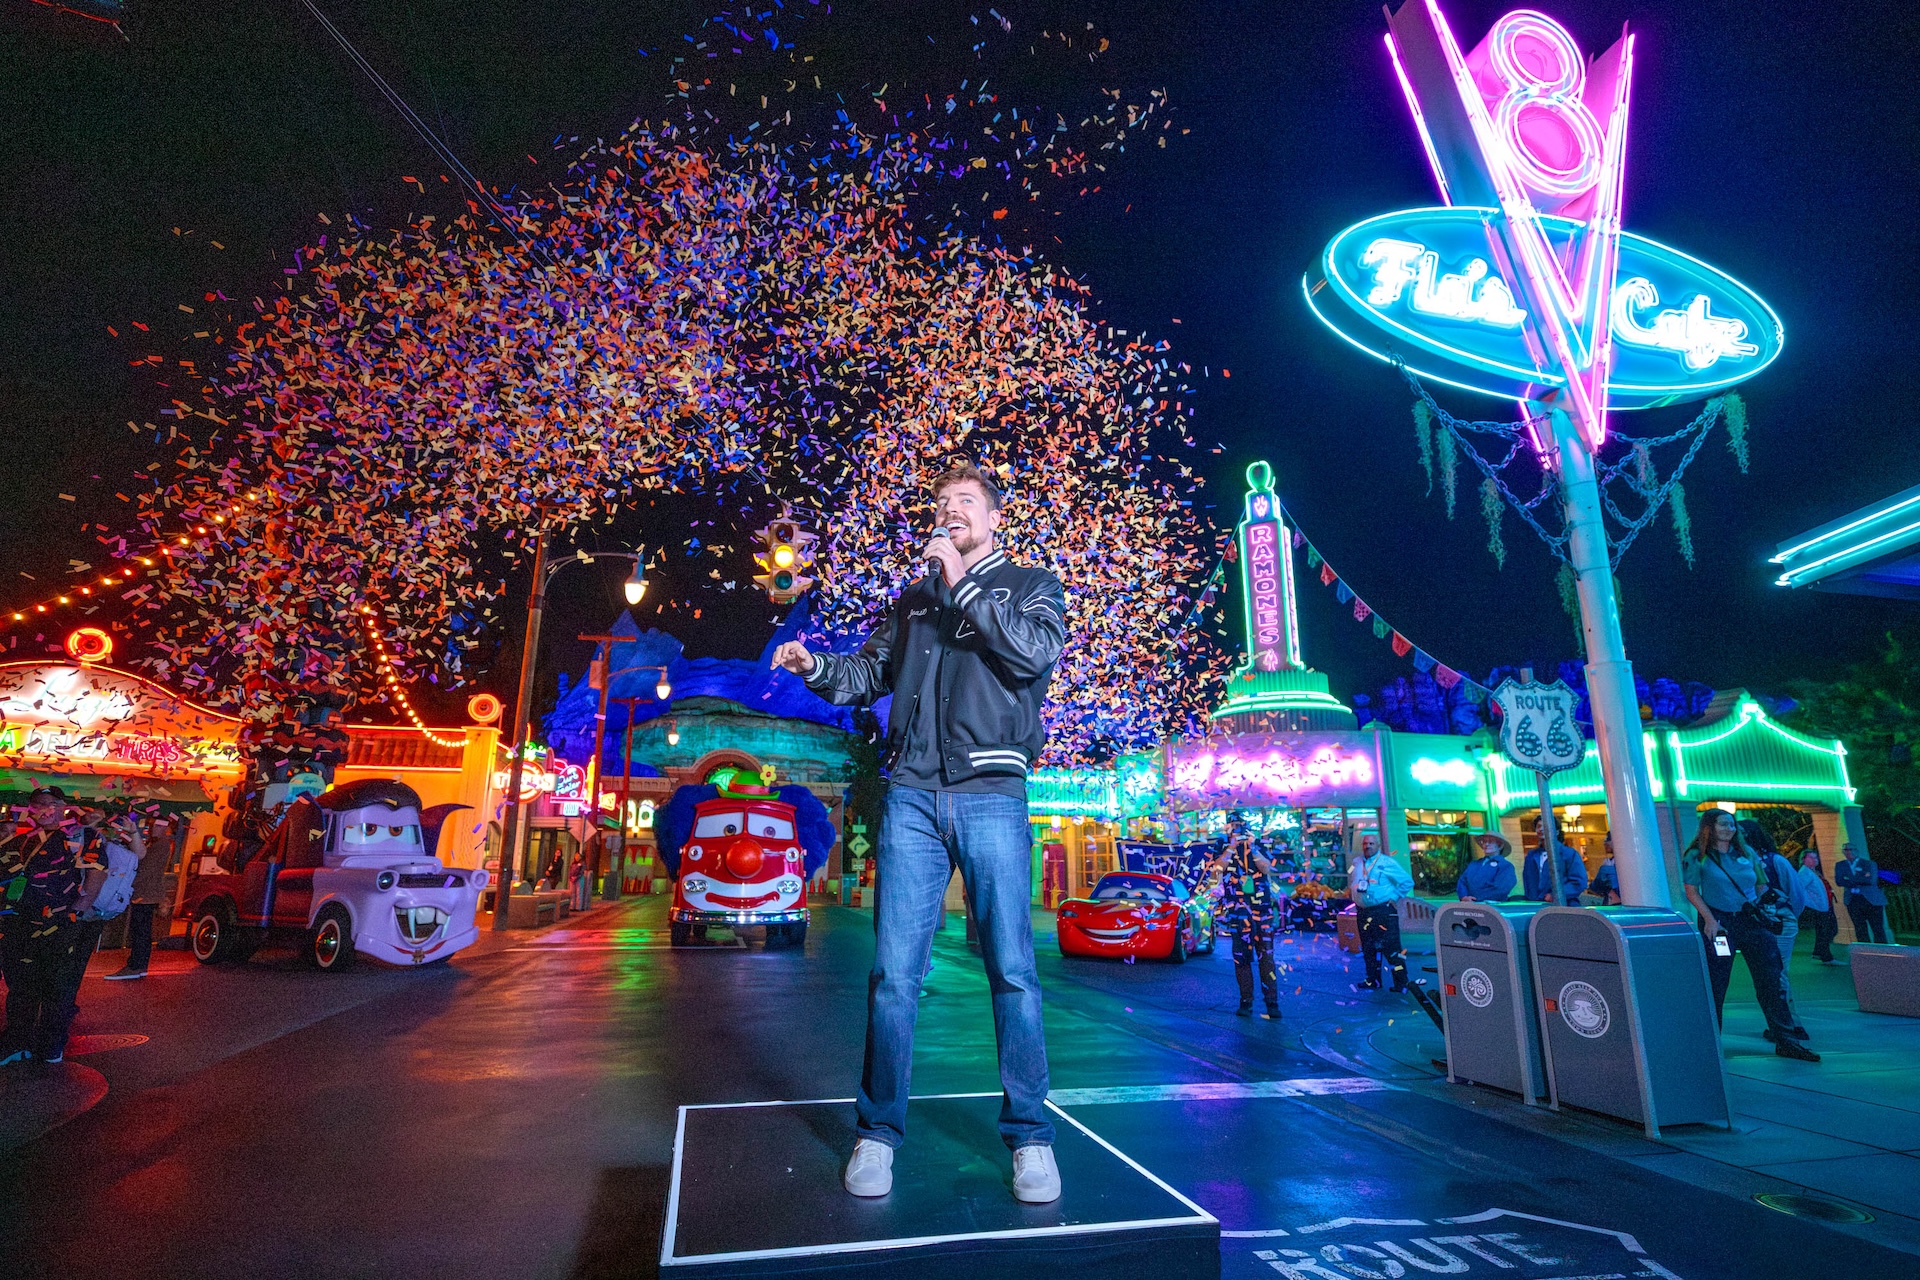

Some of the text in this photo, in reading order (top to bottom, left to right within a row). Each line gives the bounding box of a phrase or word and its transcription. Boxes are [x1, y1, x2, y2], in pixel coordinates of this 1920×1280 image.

[1250, 525, 1280, 645] RAMONES
[1514, 694, 1562, 711] ROUTE
[1515, 714, 1574, 758] 66
[1252, 1232, 1576, 1280] ROUTE
